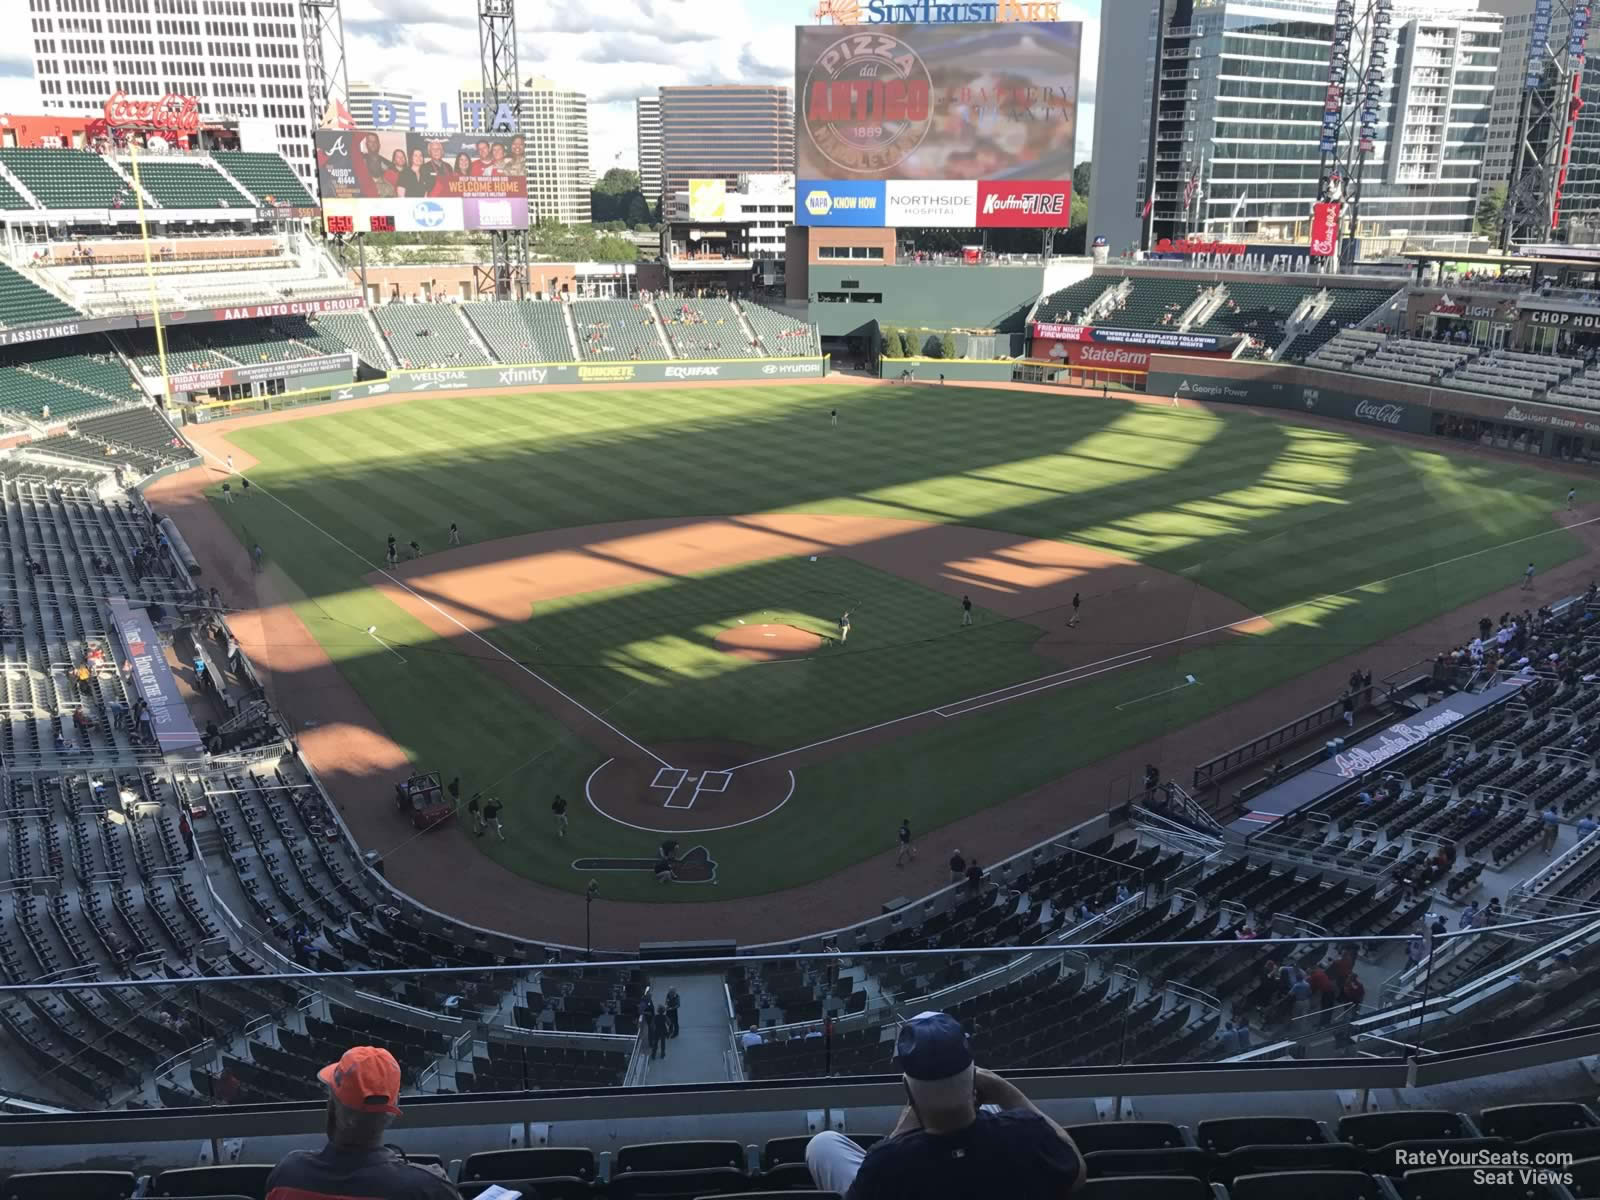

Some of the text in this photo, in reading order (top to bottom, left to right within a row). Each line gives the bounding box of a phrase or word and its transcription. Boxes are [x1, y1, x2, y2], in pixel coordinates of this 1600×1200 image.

[821, 36, 914, 76] PIZZA
[860, 64, 879, 76] dal
[372, 99, 517, 132] DELTA
[854, 128, 883, 138] 1889
[449, 182, 519, 193] WELCOME HOME
[810, 197, 877, 209] NAPA KNOW HOW
[890, 195, 973, 206] NORTHSIDE
[1022, 193, 1064, 214] TIRE
[223, 298, 361, 320] AAA AUTO CLUB GROUP
[1465, 306, 1496, 318] LIGHT
[1532, 311, 1569, 324] CHOP
[11, 324, 79, 343] ASSISTANCE!
[1040, 331, 1080, 340] FIREWORKS
[1179, 336, 1216, 344] FOLLOWING
[665, 366, 721, 378] EQUIFAX
[779, 364, 820, 373] HYUNDAI
[170, 372, 224, 385] FRIDAY NIGHT
[499, 367, 548, 384] xfinity
[175, 380, 221, 392] FIREWORKS
[1192, 384, 1248, 397] Georgia Power
[1355, 400, 1404, 424] Coca-Cola
[134, 655, 154, 677] HOME
[144, 683, 163, 698] THE
